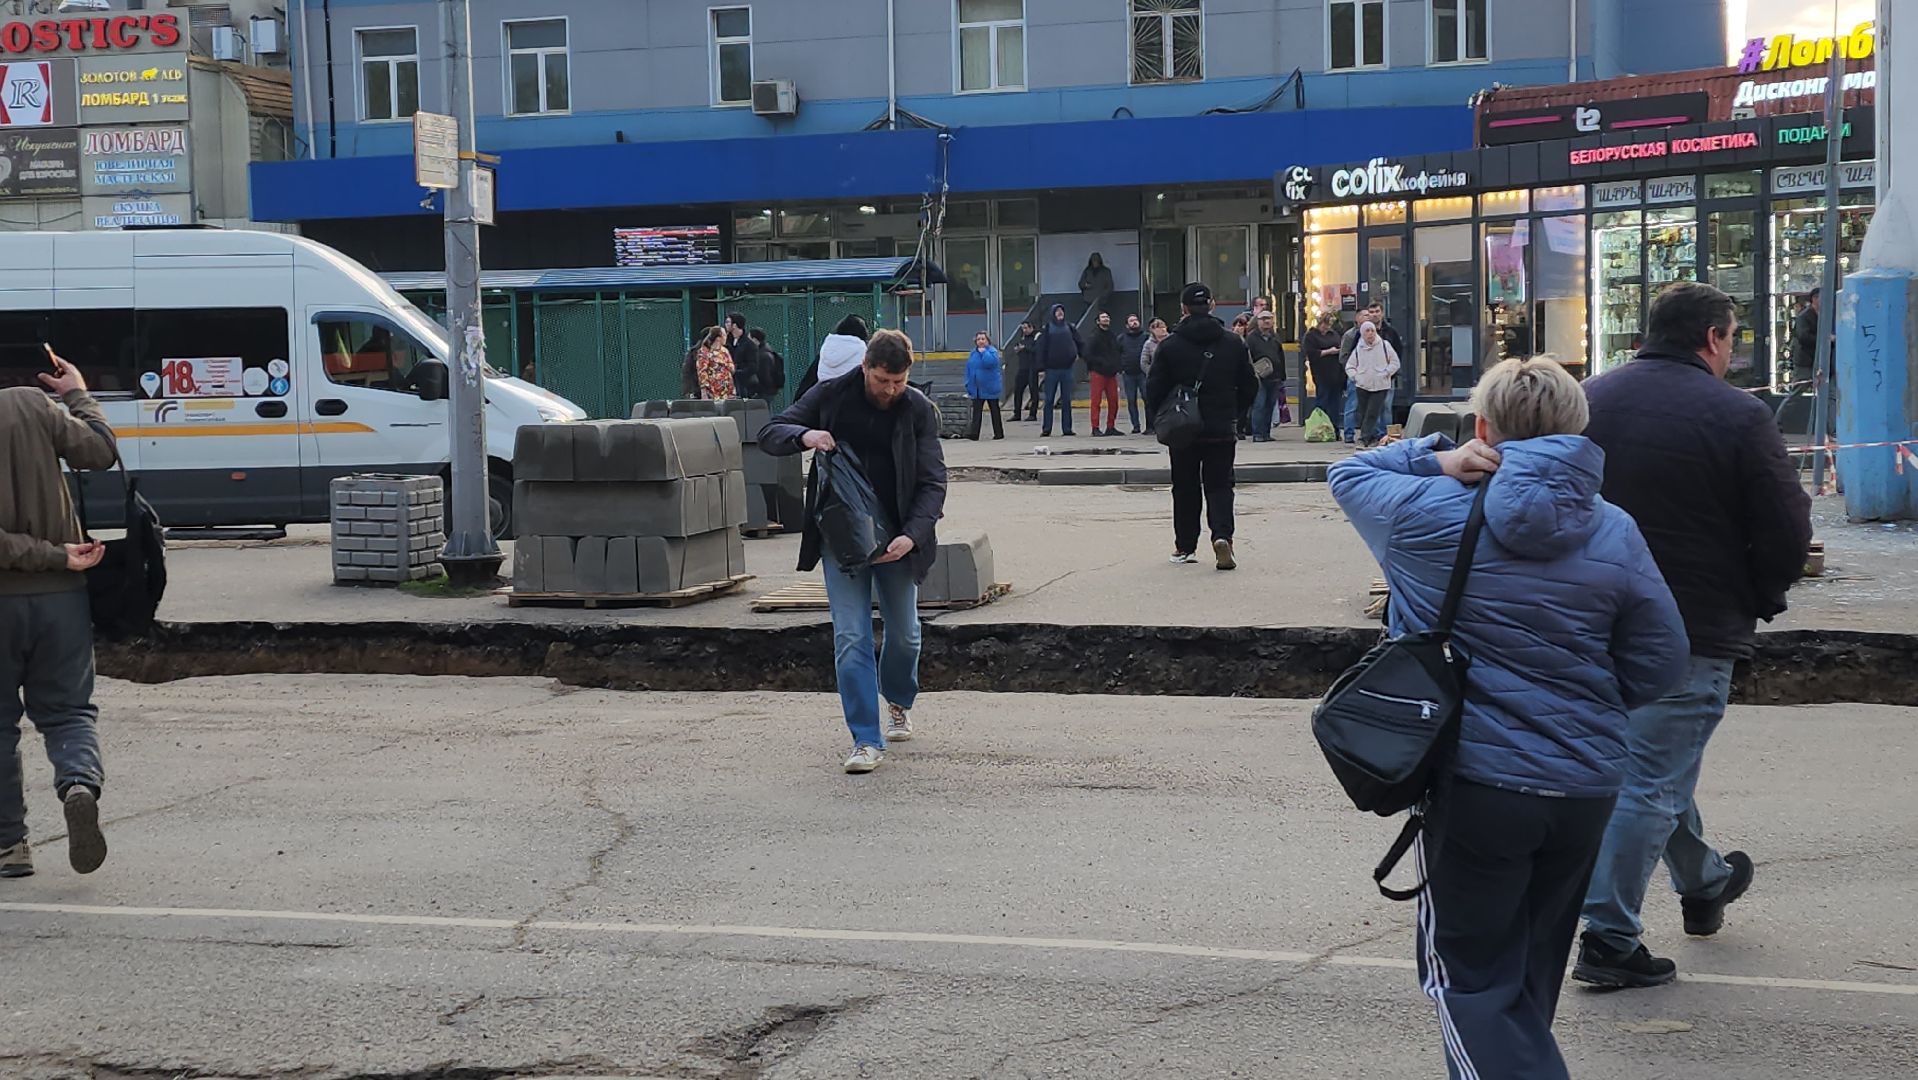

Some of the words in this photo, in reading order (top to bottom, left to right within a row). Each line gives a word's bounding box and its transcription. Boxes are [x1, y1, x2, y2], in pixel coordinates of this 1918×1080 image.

[0, 14, 179, 53] OSTIC'S
[1739, 22, 1876, 73] #Ломб
[81, 92, 150, 106] ЛОМБАРД
[84, 129, 186, 156] ЛОМБАРД
[1778, 122, 1852, 144] ПОДАРИ
[1570, 141, 1667, 165] БЕЛОРУССКАЯ
[1671, 132, 1758, 154] КОСМЕТИКА
[94, 159, 175, 171] ЮВЕЛИРНАЯ
[1331, 156, 1402, 198] cofix
[1845, 166, 1876, 183] ША
[94, 172, 176, 185] МАСТЕРСКАЯ
